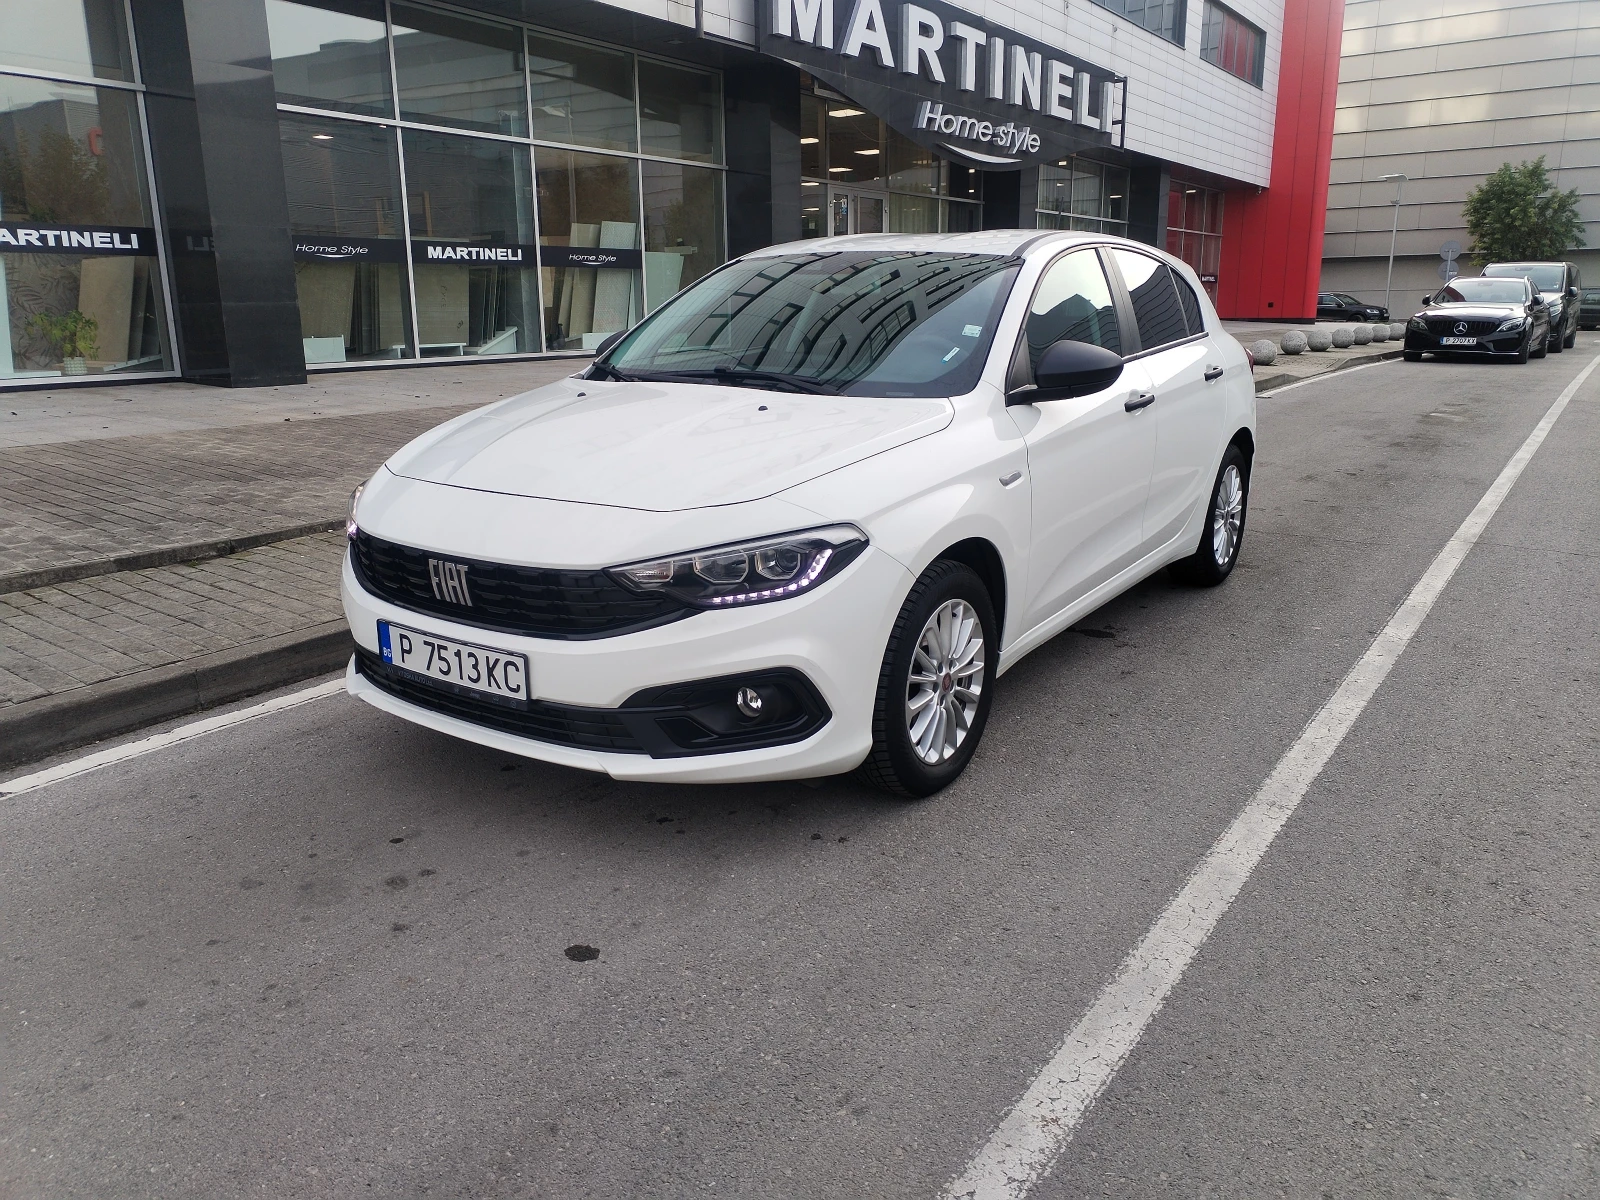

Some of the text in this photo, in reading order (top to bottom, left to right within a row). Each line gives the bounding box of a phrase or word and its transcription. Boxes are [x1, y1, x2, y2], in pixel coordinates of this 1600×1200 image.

[774, 0, 1114, 133] MARTINELI
[918, 101, 1041, 154] Home style
[295, 244, 369, 255] Home Style
[427, 246, 523, 261] MARTINELI
[598, 254, 617, 263] Style
[428, 559, 473, 607] FIAT
[383, 646, 392, 658] BG
[399, 632, 413, 664] P
[423, 639, 522, 694] 7513KC
